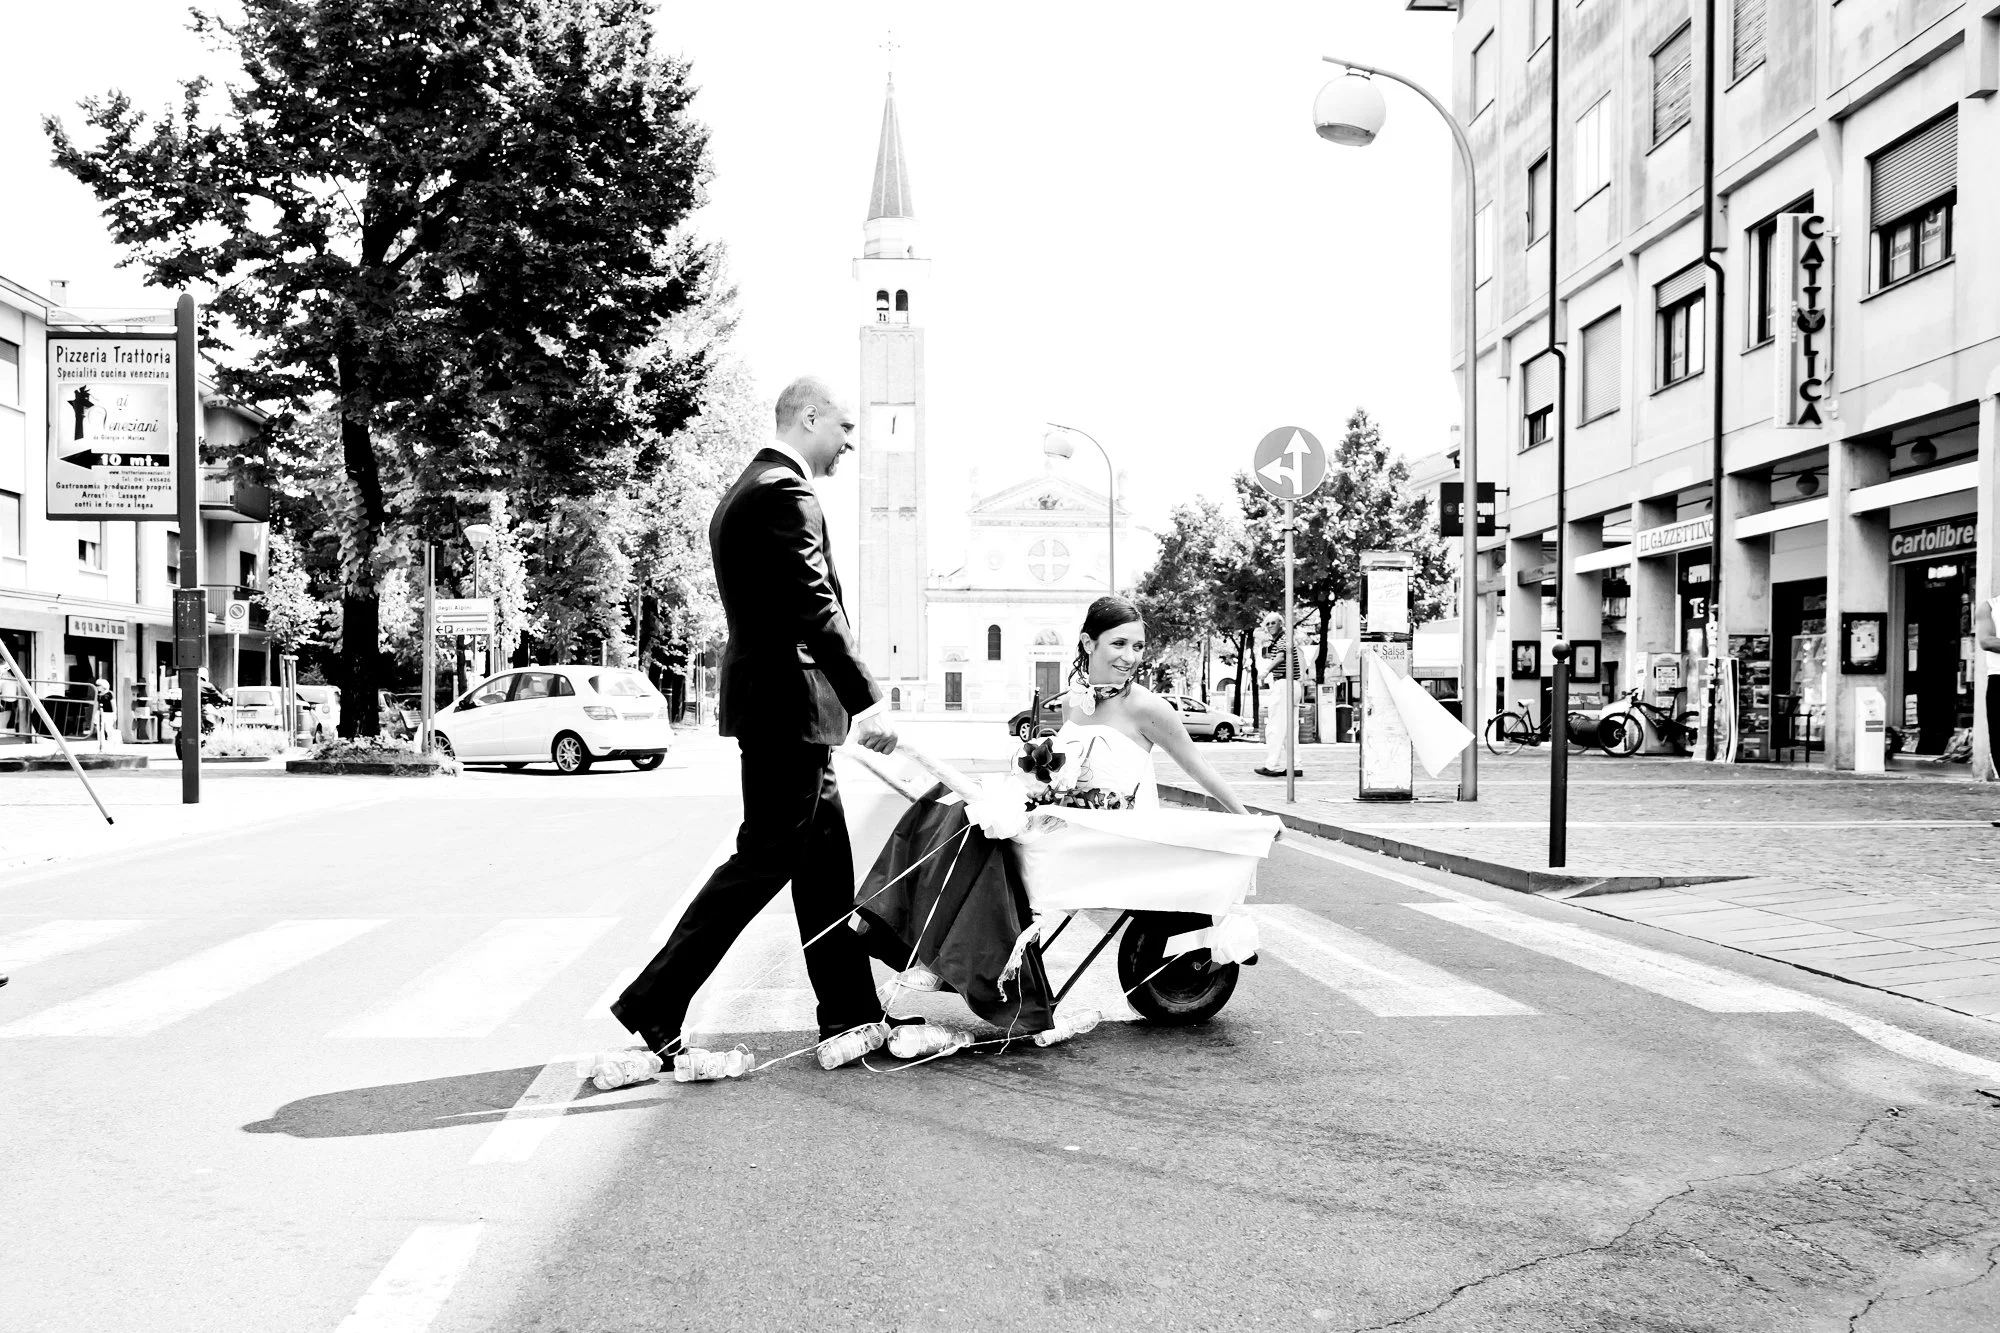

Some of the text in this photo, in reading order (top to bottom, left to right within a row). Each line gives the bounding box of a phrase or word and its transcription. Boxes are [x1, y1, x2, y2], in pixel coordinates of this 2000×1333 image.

[1797, 215, 1825, 424] CATTOLICA
[56, 345, 170, 364] Pizzeria Trattoria
[57, 366, 169, 381] Specialità cucina veneziana
[92, 406, 158, 432] Veneziani
[100, 453, 160, 467] 10 mt.
[104, 483, 143, 491] produzione
[146, 484, 172, 492] propria
[81, 491, 108, 499] Arrosti
[118, 491, 146, 501] Lasagne
[134, 499, 154, 510] legna
[1640, 535, 1649, 552] IL
[75, 621, 125, 635] aquarium
[1382, 645, 1405, 656] Salsa
